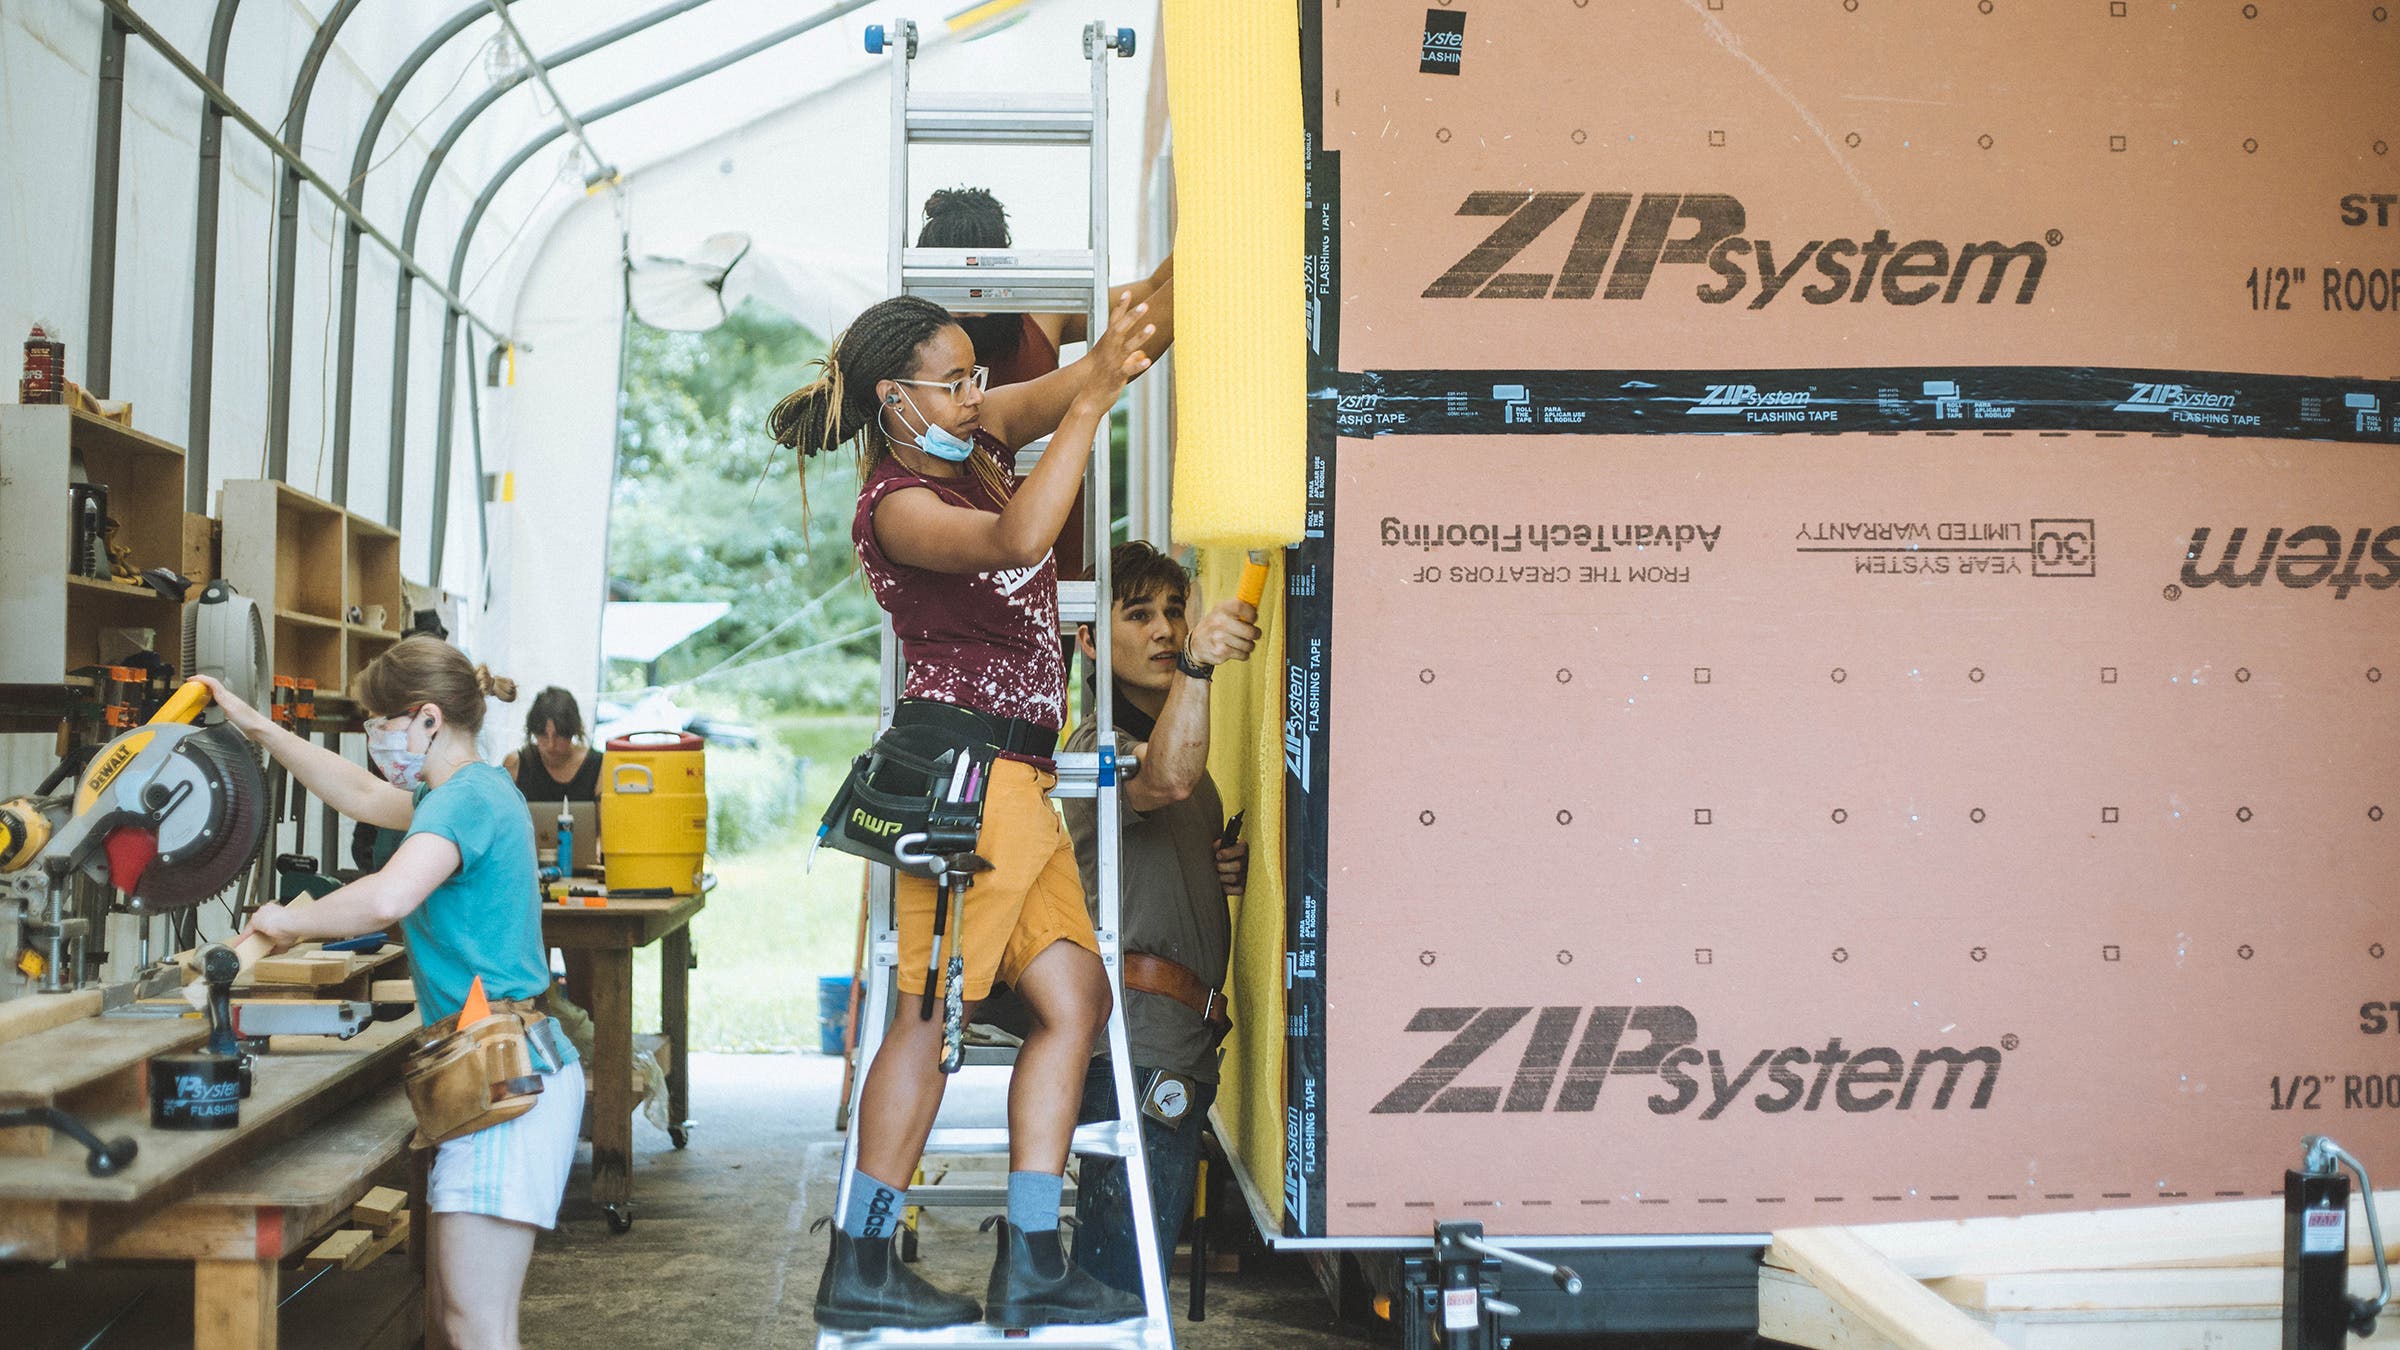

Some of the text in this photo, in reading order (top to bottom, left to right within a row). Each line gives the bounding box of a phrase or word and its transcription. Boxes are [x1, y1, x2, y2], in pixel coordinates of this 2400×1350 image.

[1375, 413, 1406, 424] TAPE
[1747, 411, 1838, 422] FLASHING TAPE
[2172, 411, 2261, 425] FLASHING TAPE
[1796, 522, 2022, 541] LIMITED WARRANTY
[2038, 532, 2089, 566] 30
[1412, 565, 1690, 583] FROM THE CREATORS OF
[1855, 556, 2022, 575] YEAR SYSTEM
[1309, 638, 1321, 732] FLASHING TAPE
[852, 808, 903, 837] AWP
[1305, 1078, 1315, 1173] FLASHING TAPE
